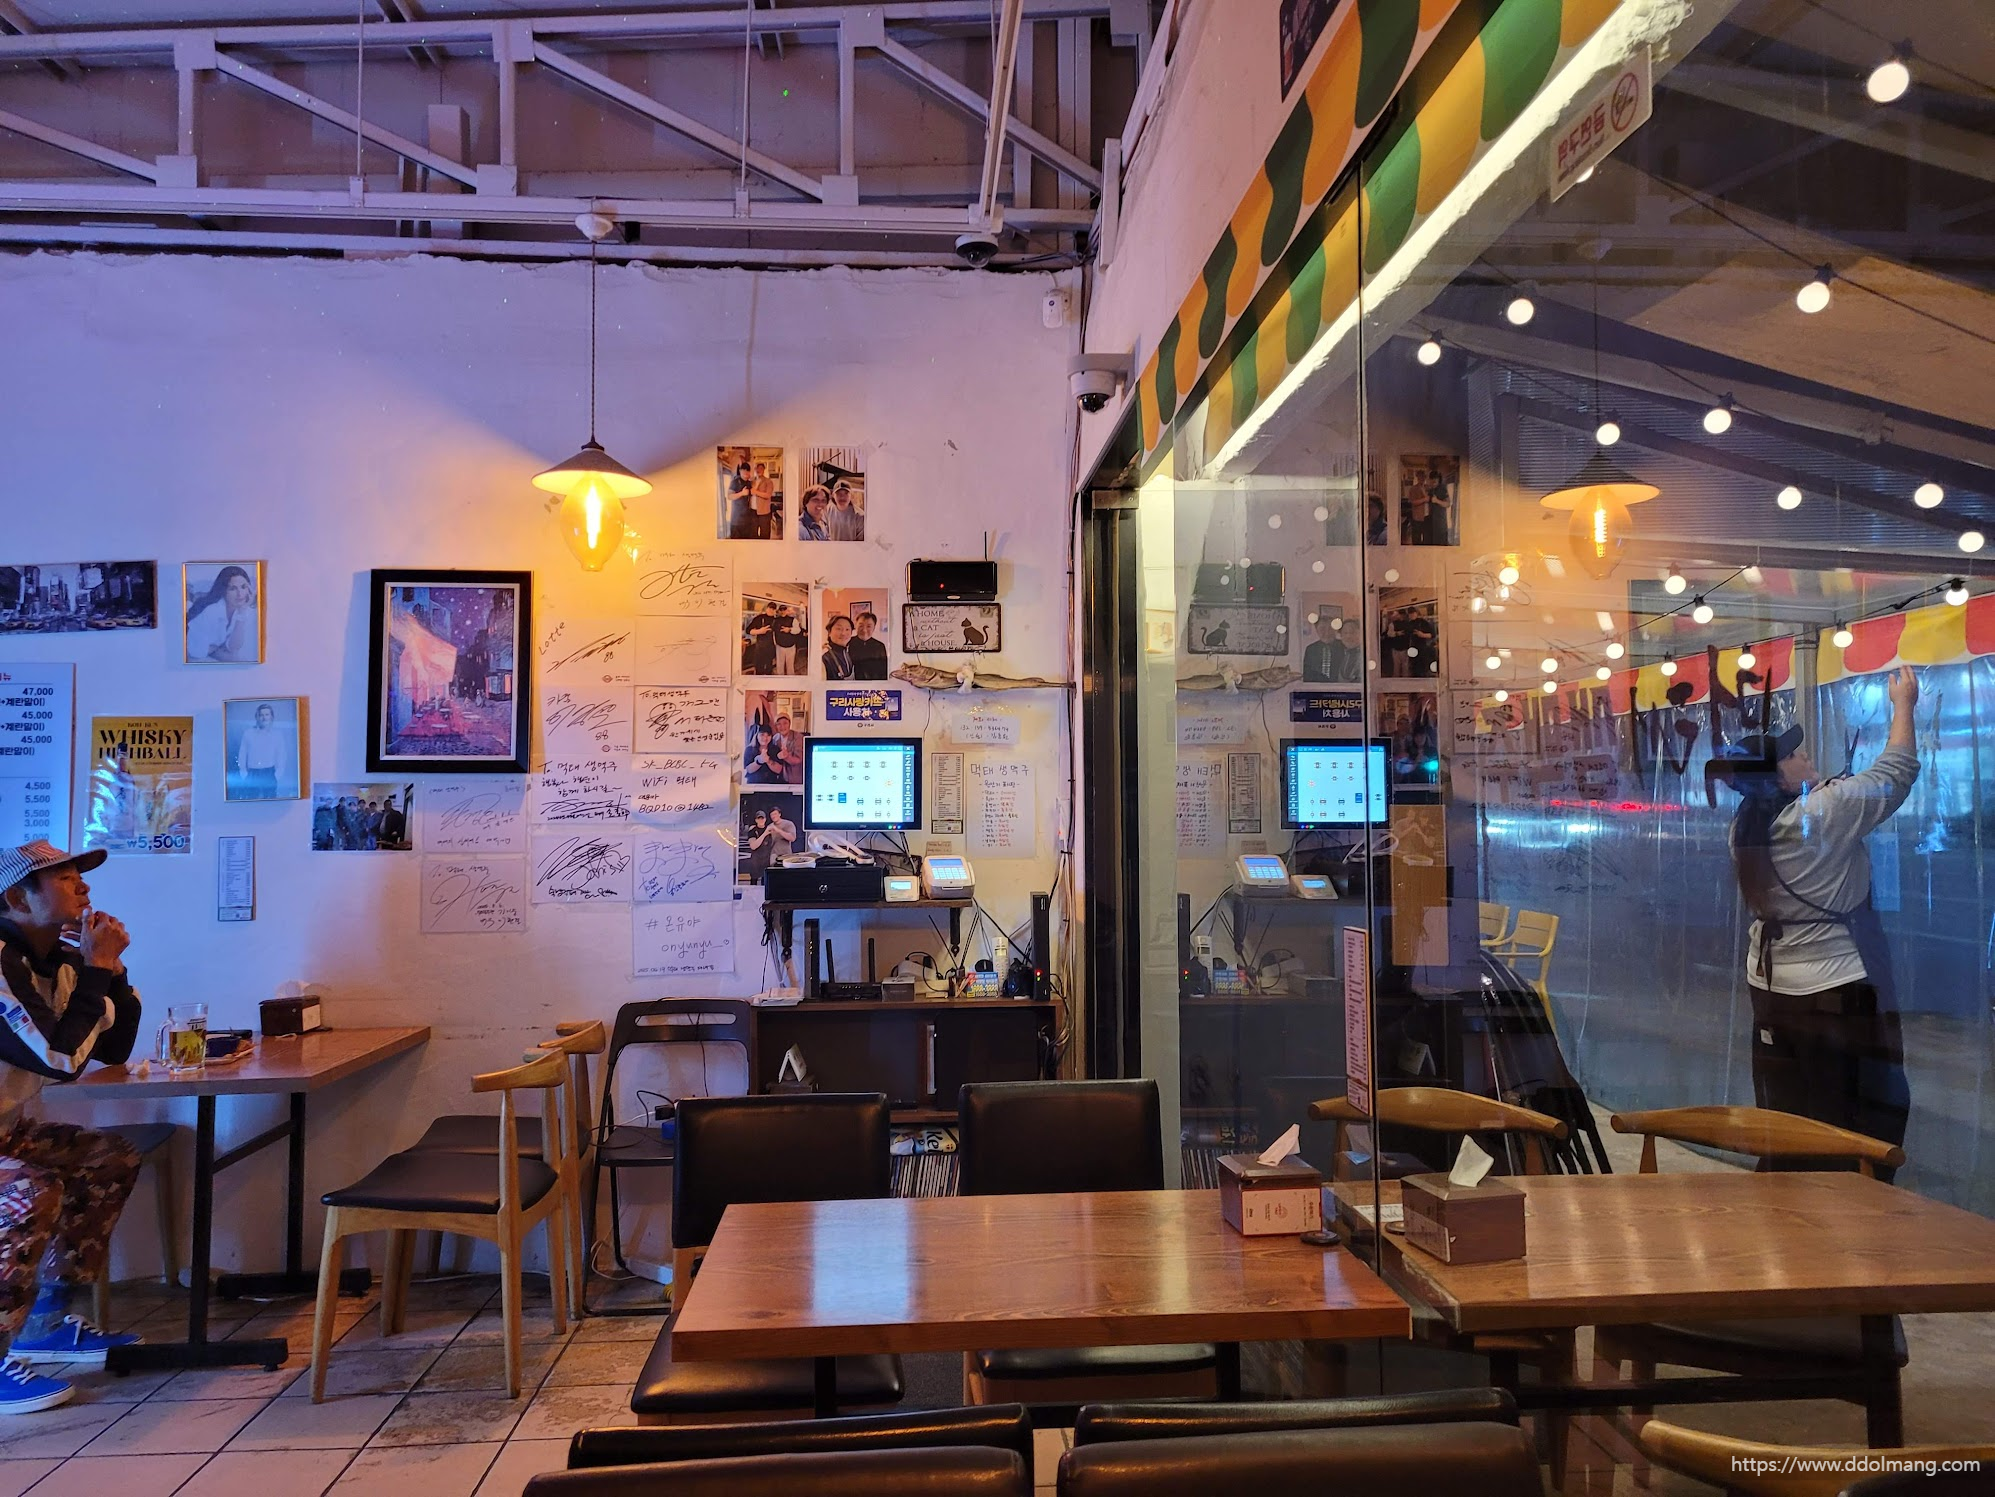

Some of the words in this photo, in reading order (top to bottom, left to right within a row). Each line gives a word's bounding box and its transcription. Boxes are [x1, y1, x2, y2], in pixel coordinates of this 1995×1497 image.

[22, 687, 54, 696] 47,000
[21, 711, 53, 720] 45,000
[20, 735, 53, 744] 45,000
[99, 729, 187, 745] WHISKY
[99, 746, 187, 759] HIHBALL
[970, 763, 994, 777] 먹태
[25, 782, 51, 790] 4,500
[25, 795, 51, 803] 5,500
[24, 809, 50, 818] 5,500
[24, 819, 50, 827] 3,000
[126, 835, 185, 851] ₩5,500
[665, 915, 702, 932] 온유야
